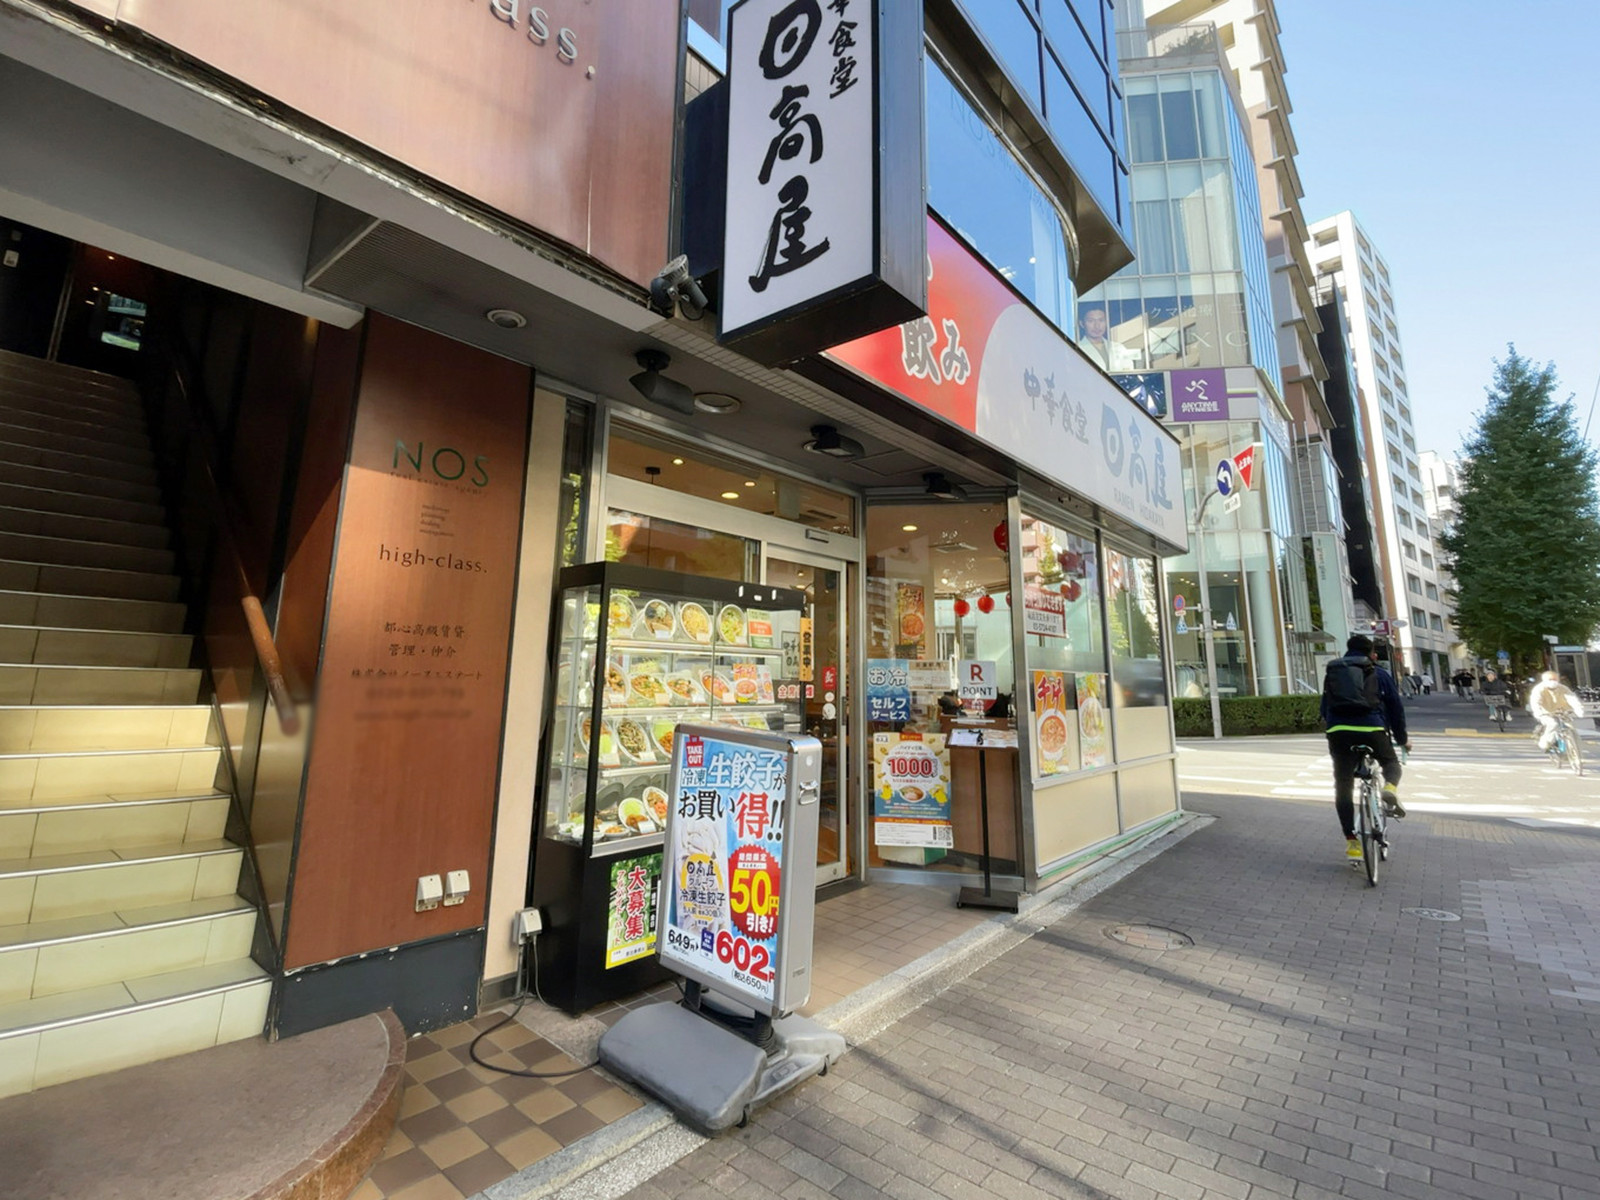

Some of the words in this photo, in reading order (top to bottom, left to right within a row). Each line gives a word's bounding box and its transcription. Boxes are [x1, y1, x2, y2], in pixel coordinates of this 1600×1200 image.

[748, 0, 830, 292] 日高屋
[1023, 366, 1089, 445] 中華食堂
[391, 440, 490, 487] NOS
[1100, 402, 1173, 510] 日高屋
[379, 544, 488, 573] high-class.
[869, 667, 908, 687] お冷
[962, 686, 993, 696] POINT
[871, 697, 907, 709] セルフ
[871, 710, 908, 720] サービス
[686, 745, 703, 755] TAKE
[687, 755, 702, 764] OUT
[887, 757, 933, 777] 1000
[625, 866, 646, 940] 大募集
